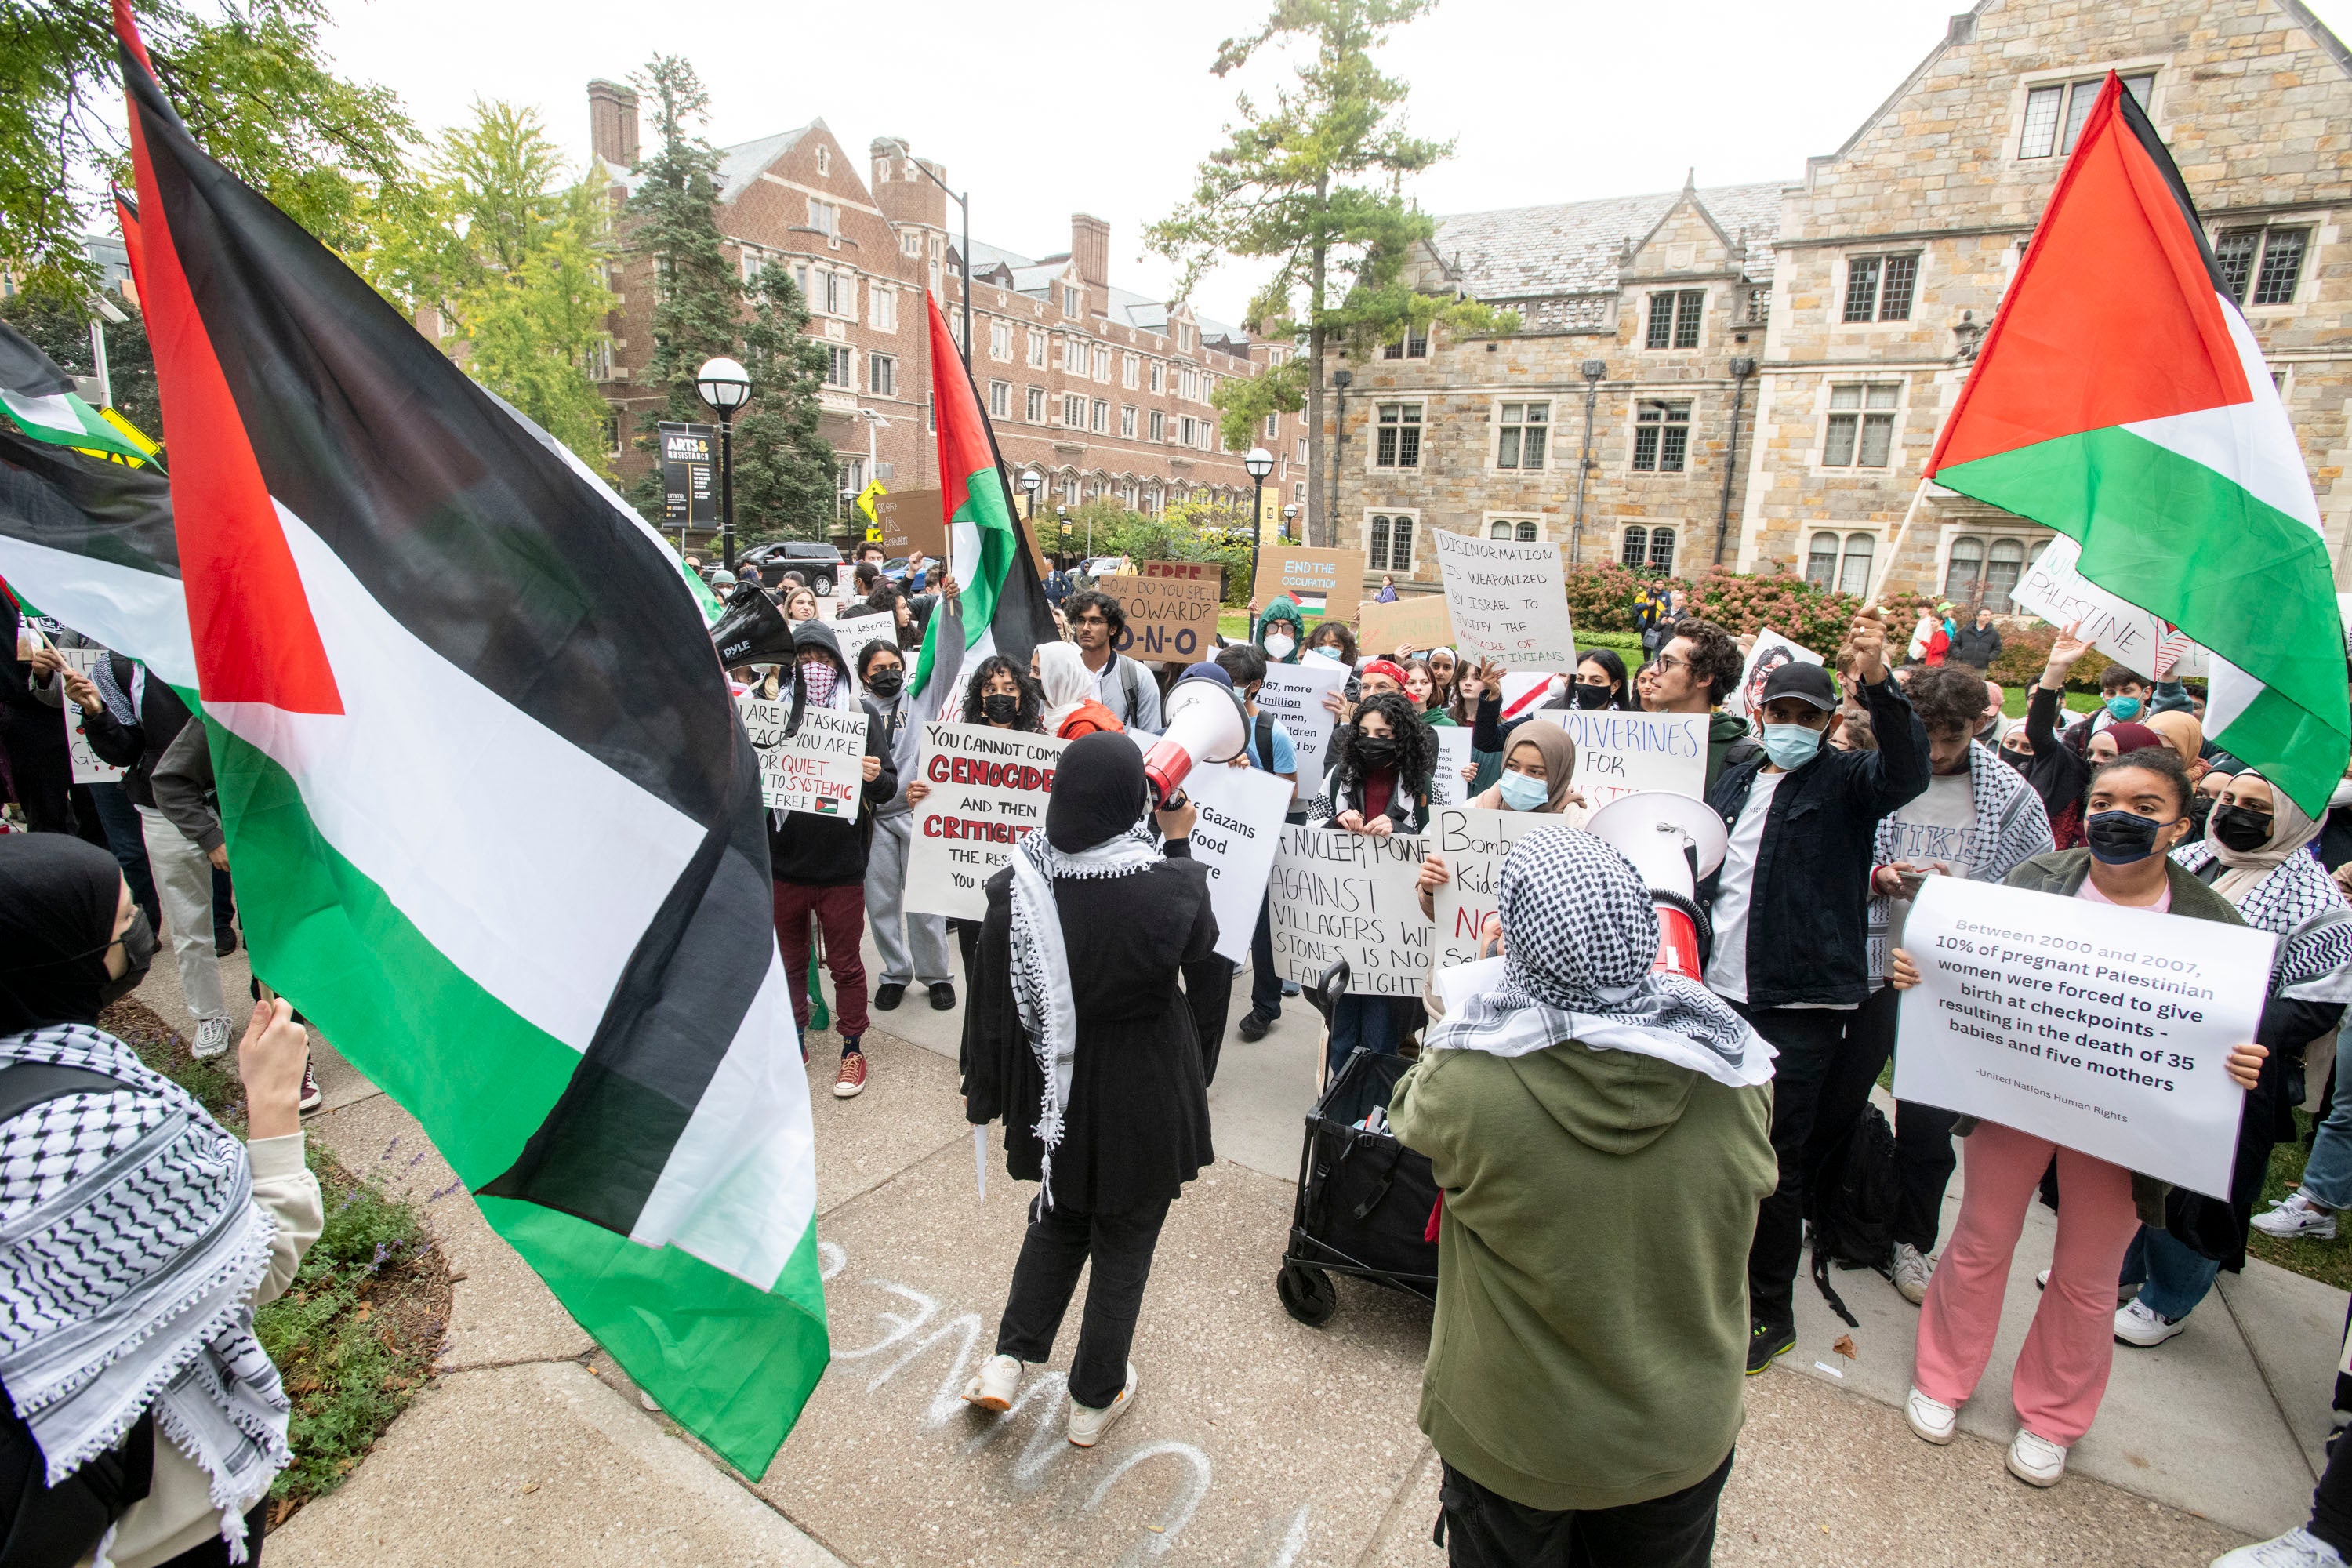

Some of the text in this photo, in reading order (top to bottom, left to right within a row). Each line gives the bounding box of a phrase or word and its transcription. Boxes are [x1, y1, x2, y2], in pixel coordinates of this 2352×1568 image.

[667, 437, 709, 452] ARTS &
[877, 503, 898, 514] NOT
[885, 517, 901, 532] A
[1439, 533, 1552, 561] DISINORMATION
[1283, 560, 1336, 574] END THE
[1445, 564, 1548, 586] IS WEAPONIZED
[1102, 579, 1218, 601] HOW DO YOU SPELL
[1281, 576, 1336, 589] OCCUPATION
[1120, 597, 1212, 622] OWARD?
[1451, 588, 1538, 611] BY ISRAEL TO
[1453, 611, 1491, 633] JUSTIFY
[1501, 622, 1528, 633] THE
[2025, 572, 2146, 655] PALESTINE
[858, 620, 892, 634] deserves
[723, 640, 750, 658] PYLE
[1517, 638, 1537, 648] OF
[1284, 684, 1312, 694] more
[1265, 696, 1301, 707] million
[746, 703, 779, 725] ARE
[814, 714, 866, 737] ASKING
[1281, 713, 1307, 724] men,
[794, 732, 822, 750] YOU
[824, 737, 858, 757] ARE
[964, 735, 1024, 757] CANNOT
[1303, 742, 1316, 753] by
[757, 751, 831, 776] OR QUIET
[927, 753, 1057, 793] GENOCIDE
[1586, 751, 1625, 778] FOR
[769, 773, 786, 789] TO
[786, 775, 854, 800] SYSTEMIC
[775, 793, 809, 809] FREE
[960, 797, 1037, 818] AND THEN
[1202, 806, 1256, 839] Gazans
[1189, 828, 1228, 855] food
[1294, 828, 1367, 869] NUCLER
[949, 848, 980, 864] THE
[951, 873, 975, 891] YOU
[1271, 864, 1381, 914] AGAINST
[1272, 901, 1385, 943] VILLAGERS
[1362, 946, 1380, 967] IS
[1955, 919, 2201, 978] Between 2000 and 2007,
[1936, 935, 2214, 1000] 10% of pregnant Palestinian
[1938, 959, 2204, 1023] women were forced to give
[1961, 982, 2002, 1004] birth
[2007, 996, 2026, 1010] at
[2031, 1000, 2154, 1038] checkpoints
[1938, 997, 2195, 1071] resulting in the death of 35
[1949, 1018, 2175, 1091] babies and five mothers
[1976, 1068, 2129, 1123] -United Nations Human Rights
